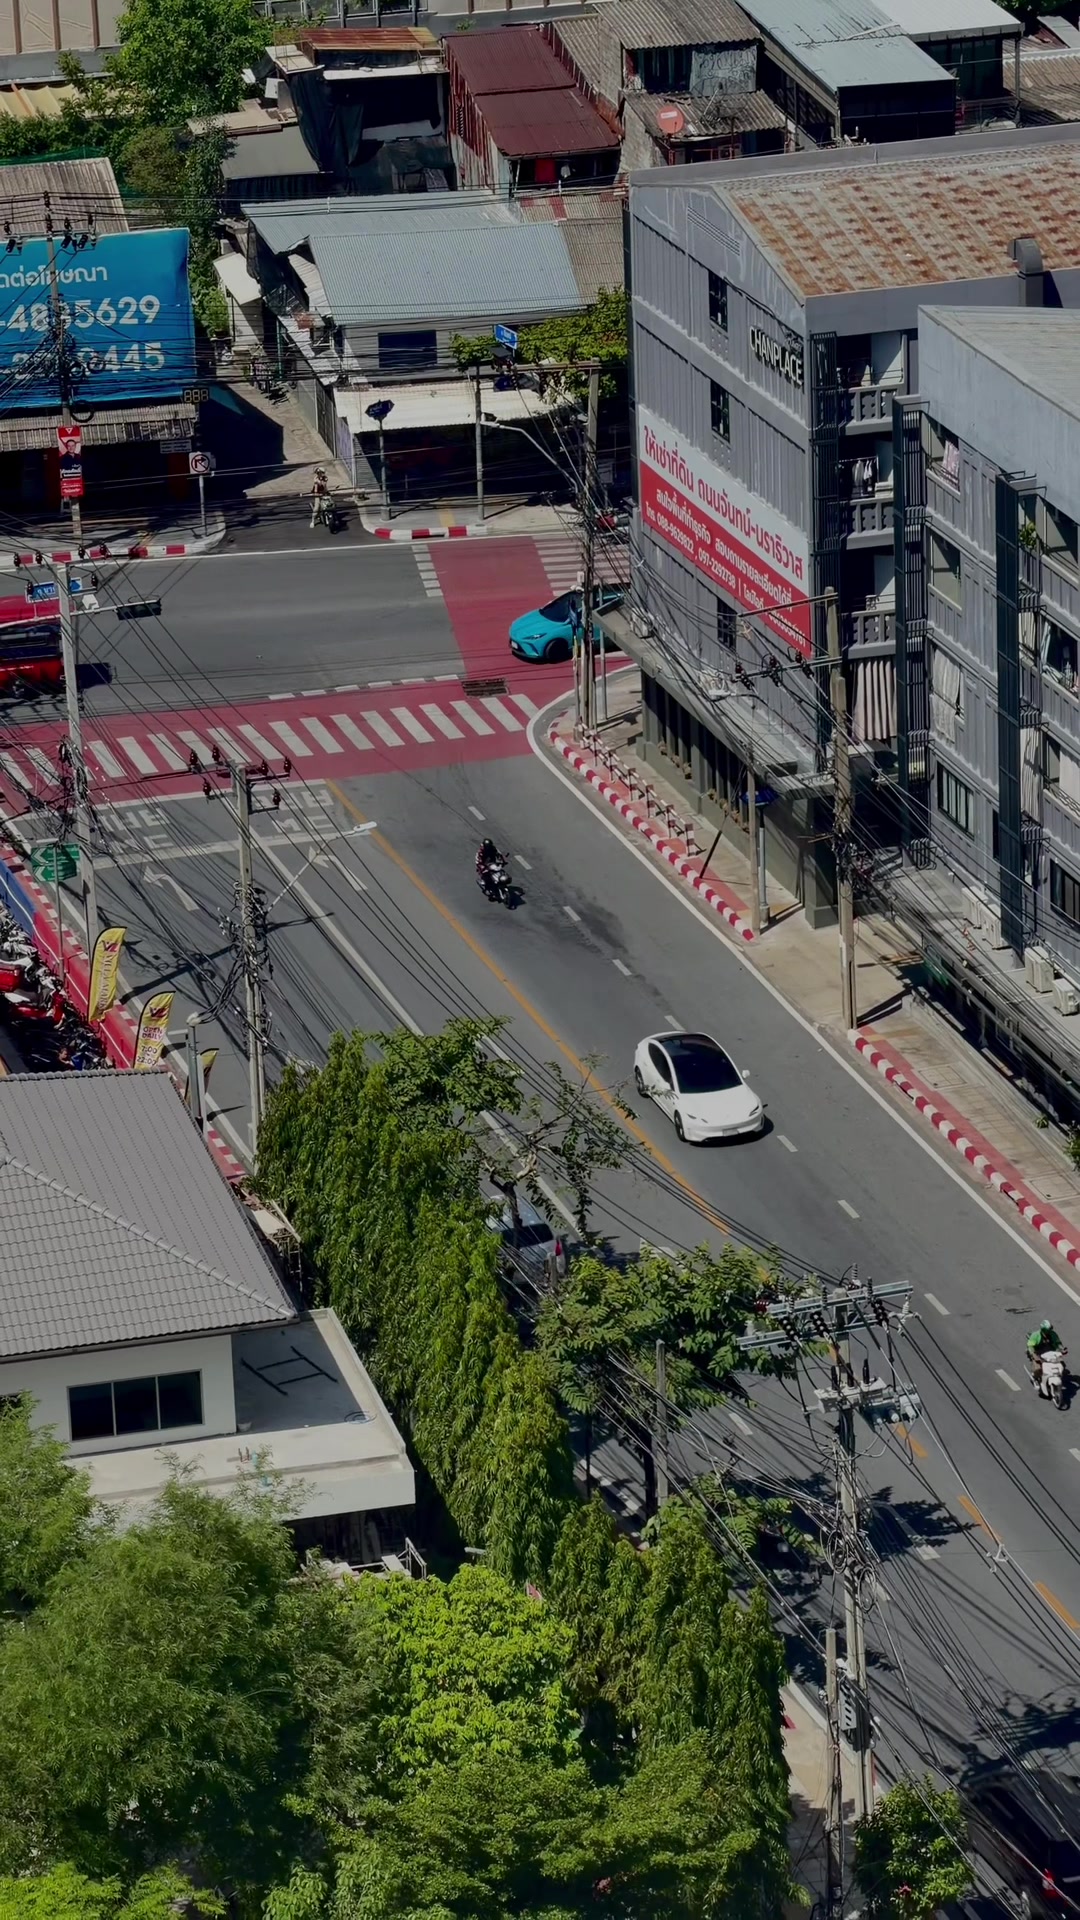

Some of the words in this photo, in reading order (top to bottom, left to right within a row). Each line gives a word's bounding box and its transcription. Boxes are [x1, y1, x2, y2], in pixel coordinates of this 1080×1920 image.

[750, 326, 803, 385] CHANPLACE
[644, 424, 694, 493] ให้เช่าที่ดิน
[698, 478, 804, 581] ถนนจันทน์-นราธิวาส
[143, 1026, 162, 1035] OPEN
